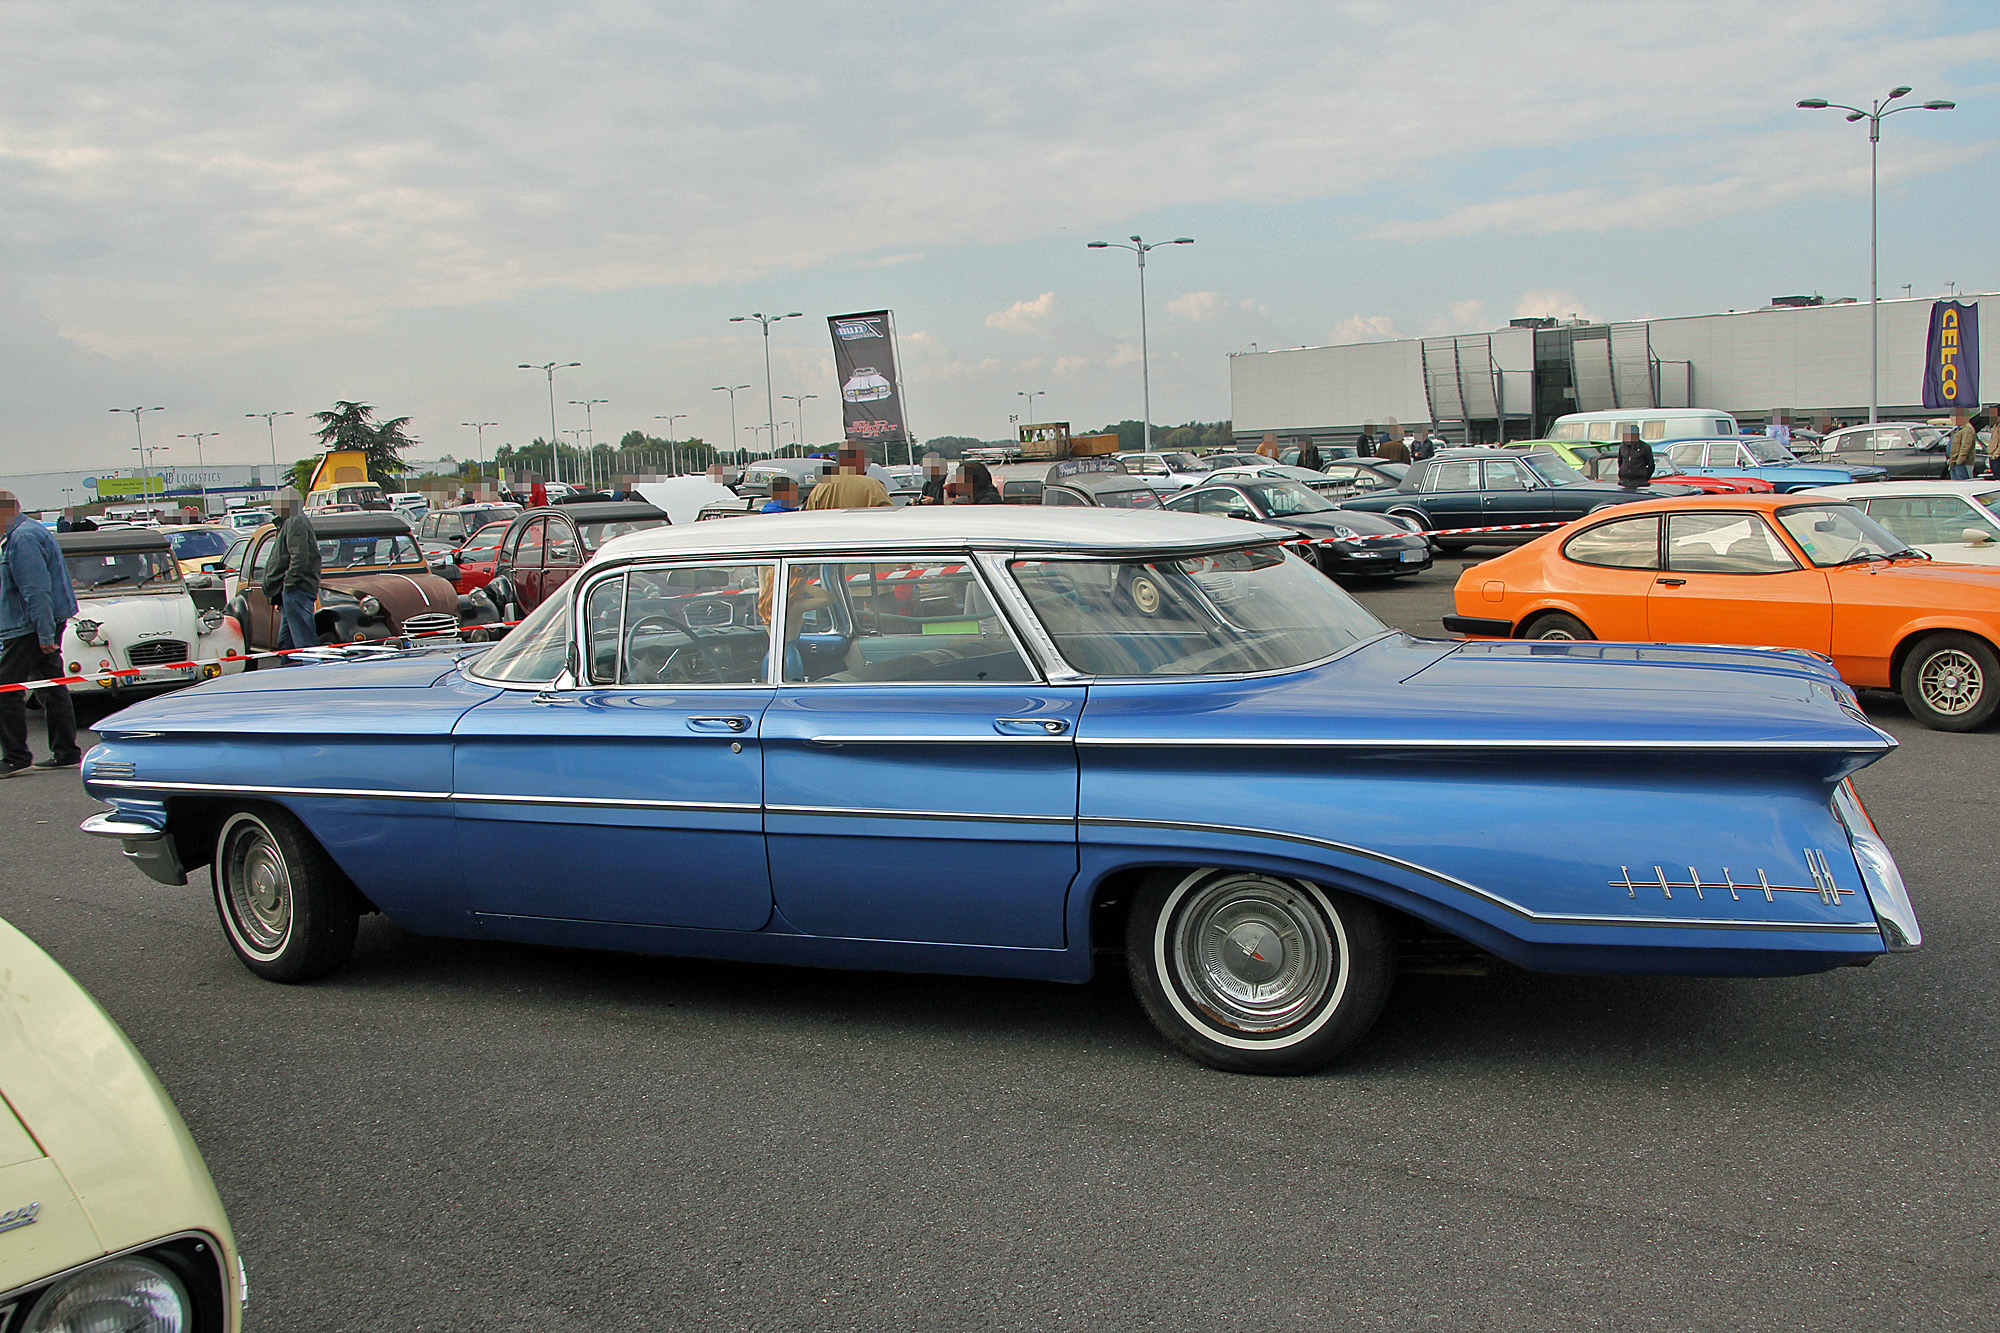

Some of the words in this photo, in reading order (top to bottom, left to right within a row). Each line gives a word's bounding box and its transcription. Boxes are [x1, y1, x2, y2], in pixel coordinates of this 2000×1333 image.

[176, 472, 221, 484] LOGISTICS
[1620, 865, 1774, 903] SUPER
[1804, 847, 1842, 906] 88
